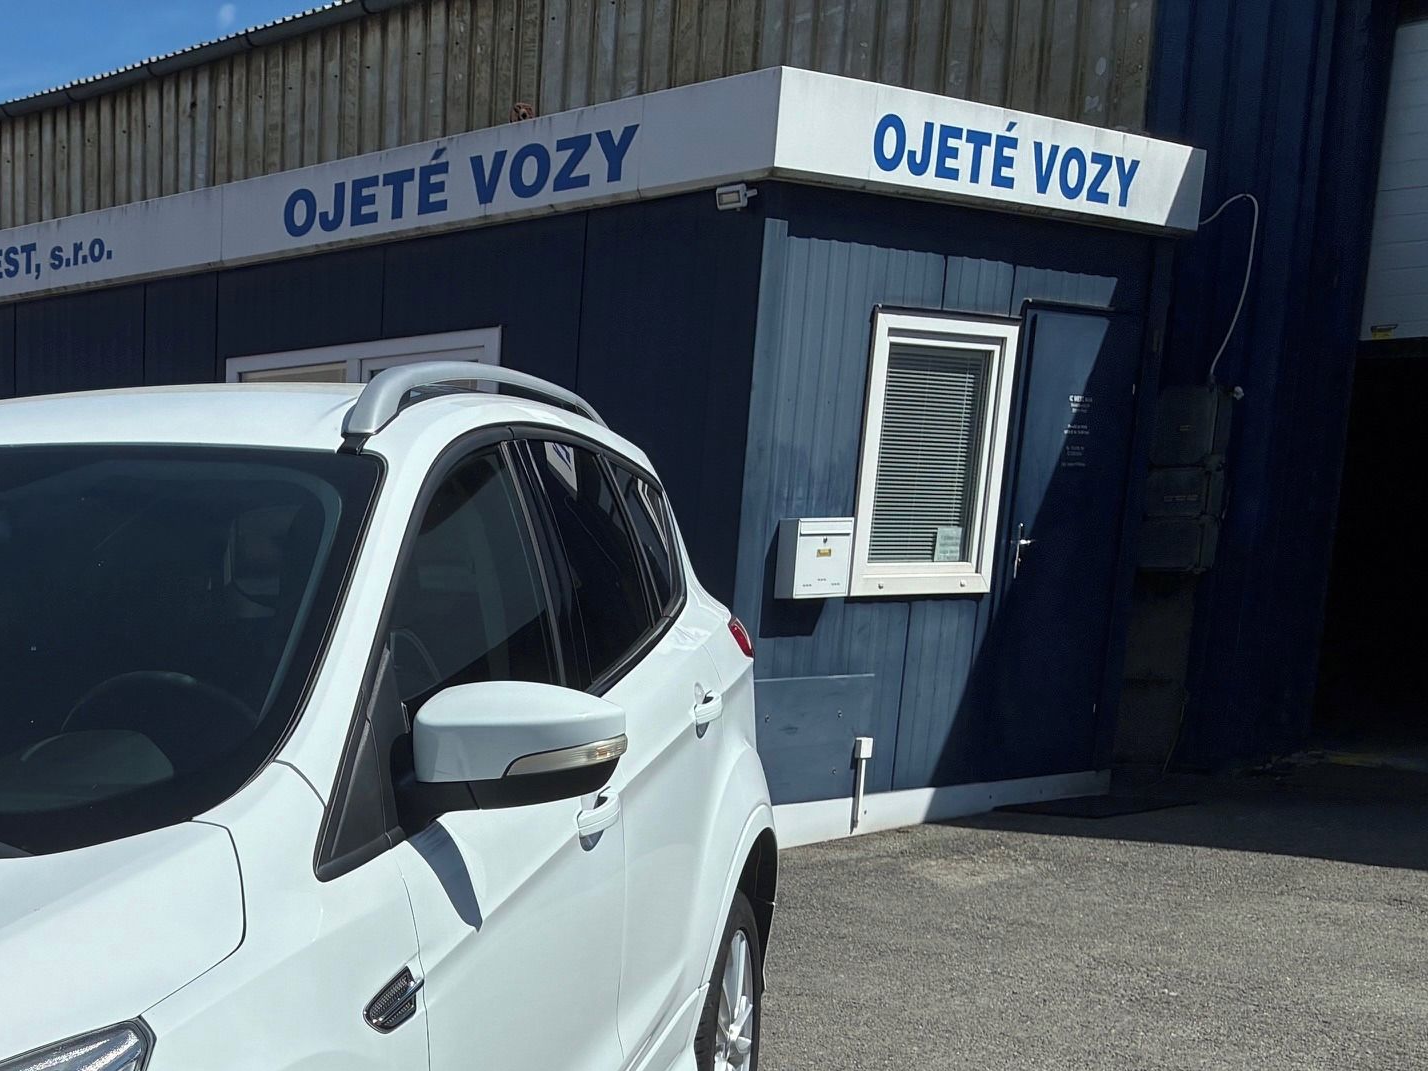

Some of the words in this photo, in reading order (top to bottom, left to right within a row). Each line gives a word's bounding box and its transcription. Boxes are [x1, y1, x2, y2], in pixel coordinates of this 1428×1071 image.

[283, 146, 450, 238] OJETÉ
[469, 123, 641, 206] VOZY
[873, 113, 1019, 190] OJETÉ
[1033, 140, 1141, 208] VOZY
[49, 237, 113, 271] s.r.o.
